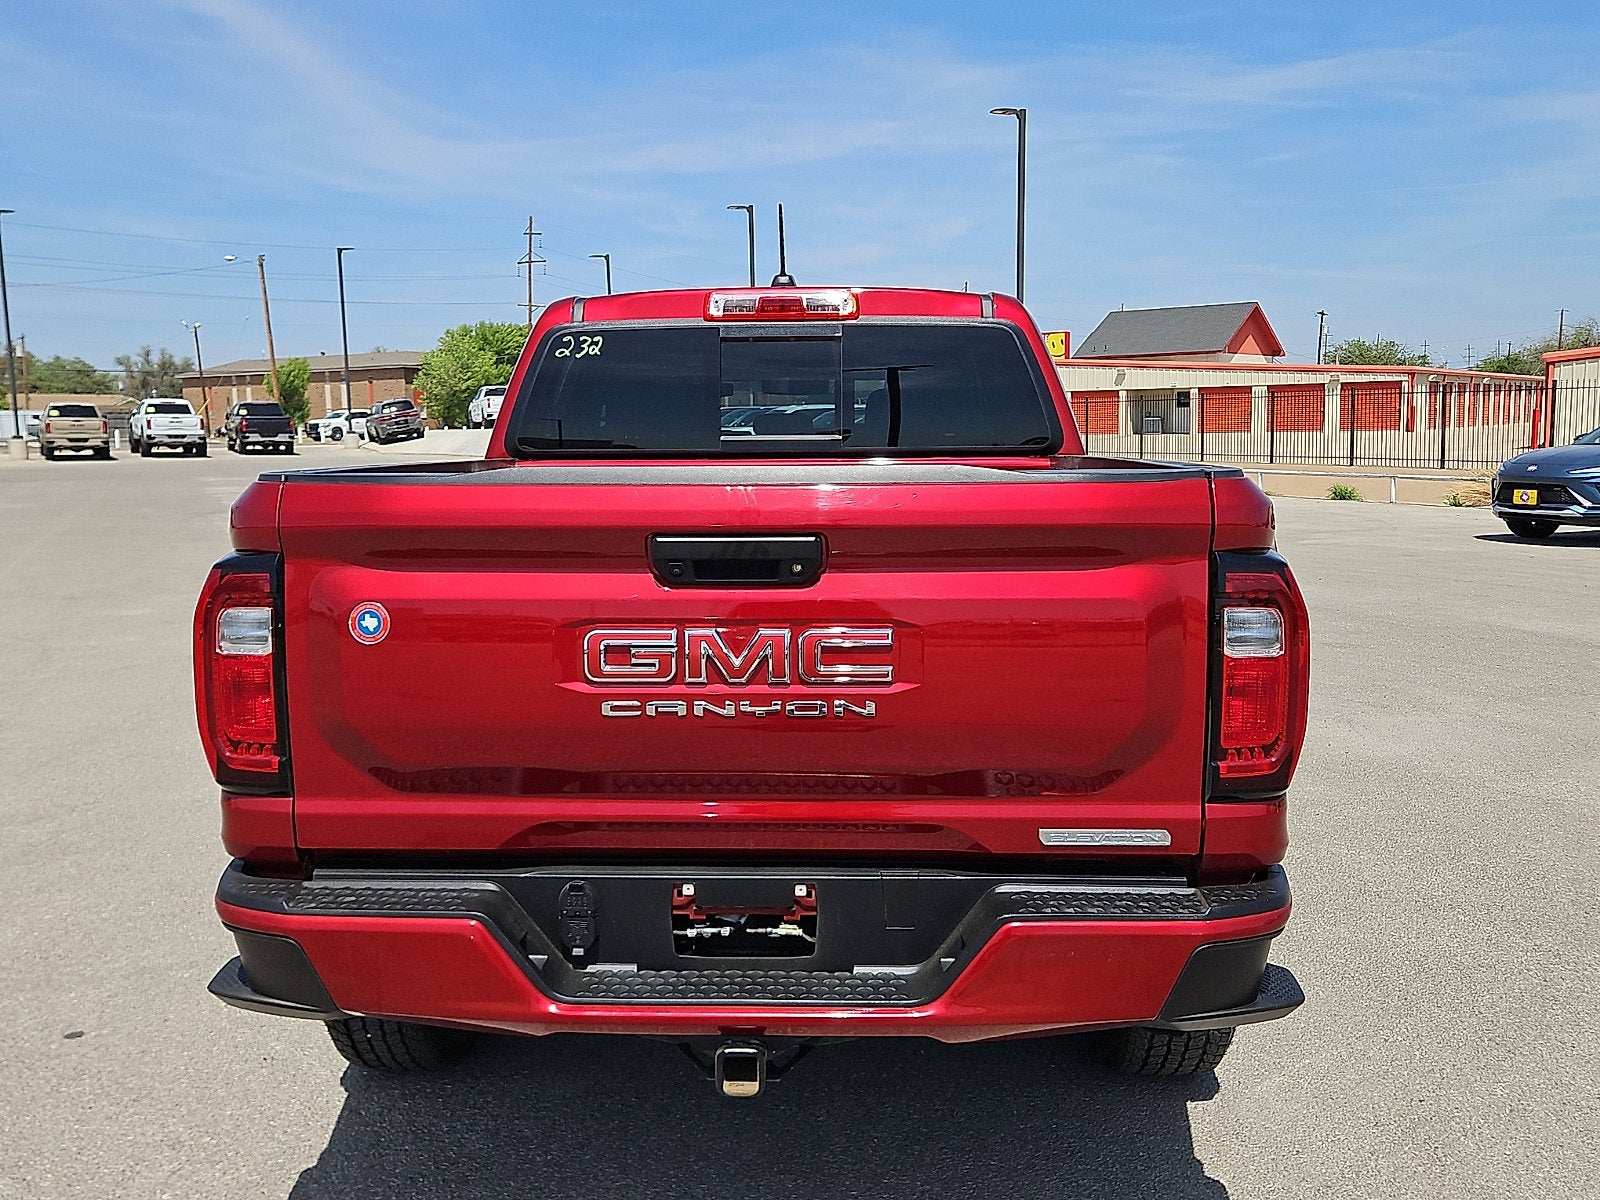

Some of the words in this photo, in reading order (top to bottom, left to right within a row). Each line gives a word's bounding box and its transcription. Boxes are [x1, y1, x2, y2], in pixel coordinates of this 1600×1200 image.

[554, 335, 604, 359] 232
[583, 627, 895, 684] GMC
[601, 700, 878, 718] CANYON
[1049, 831, 1162, 844] ELEVATION
